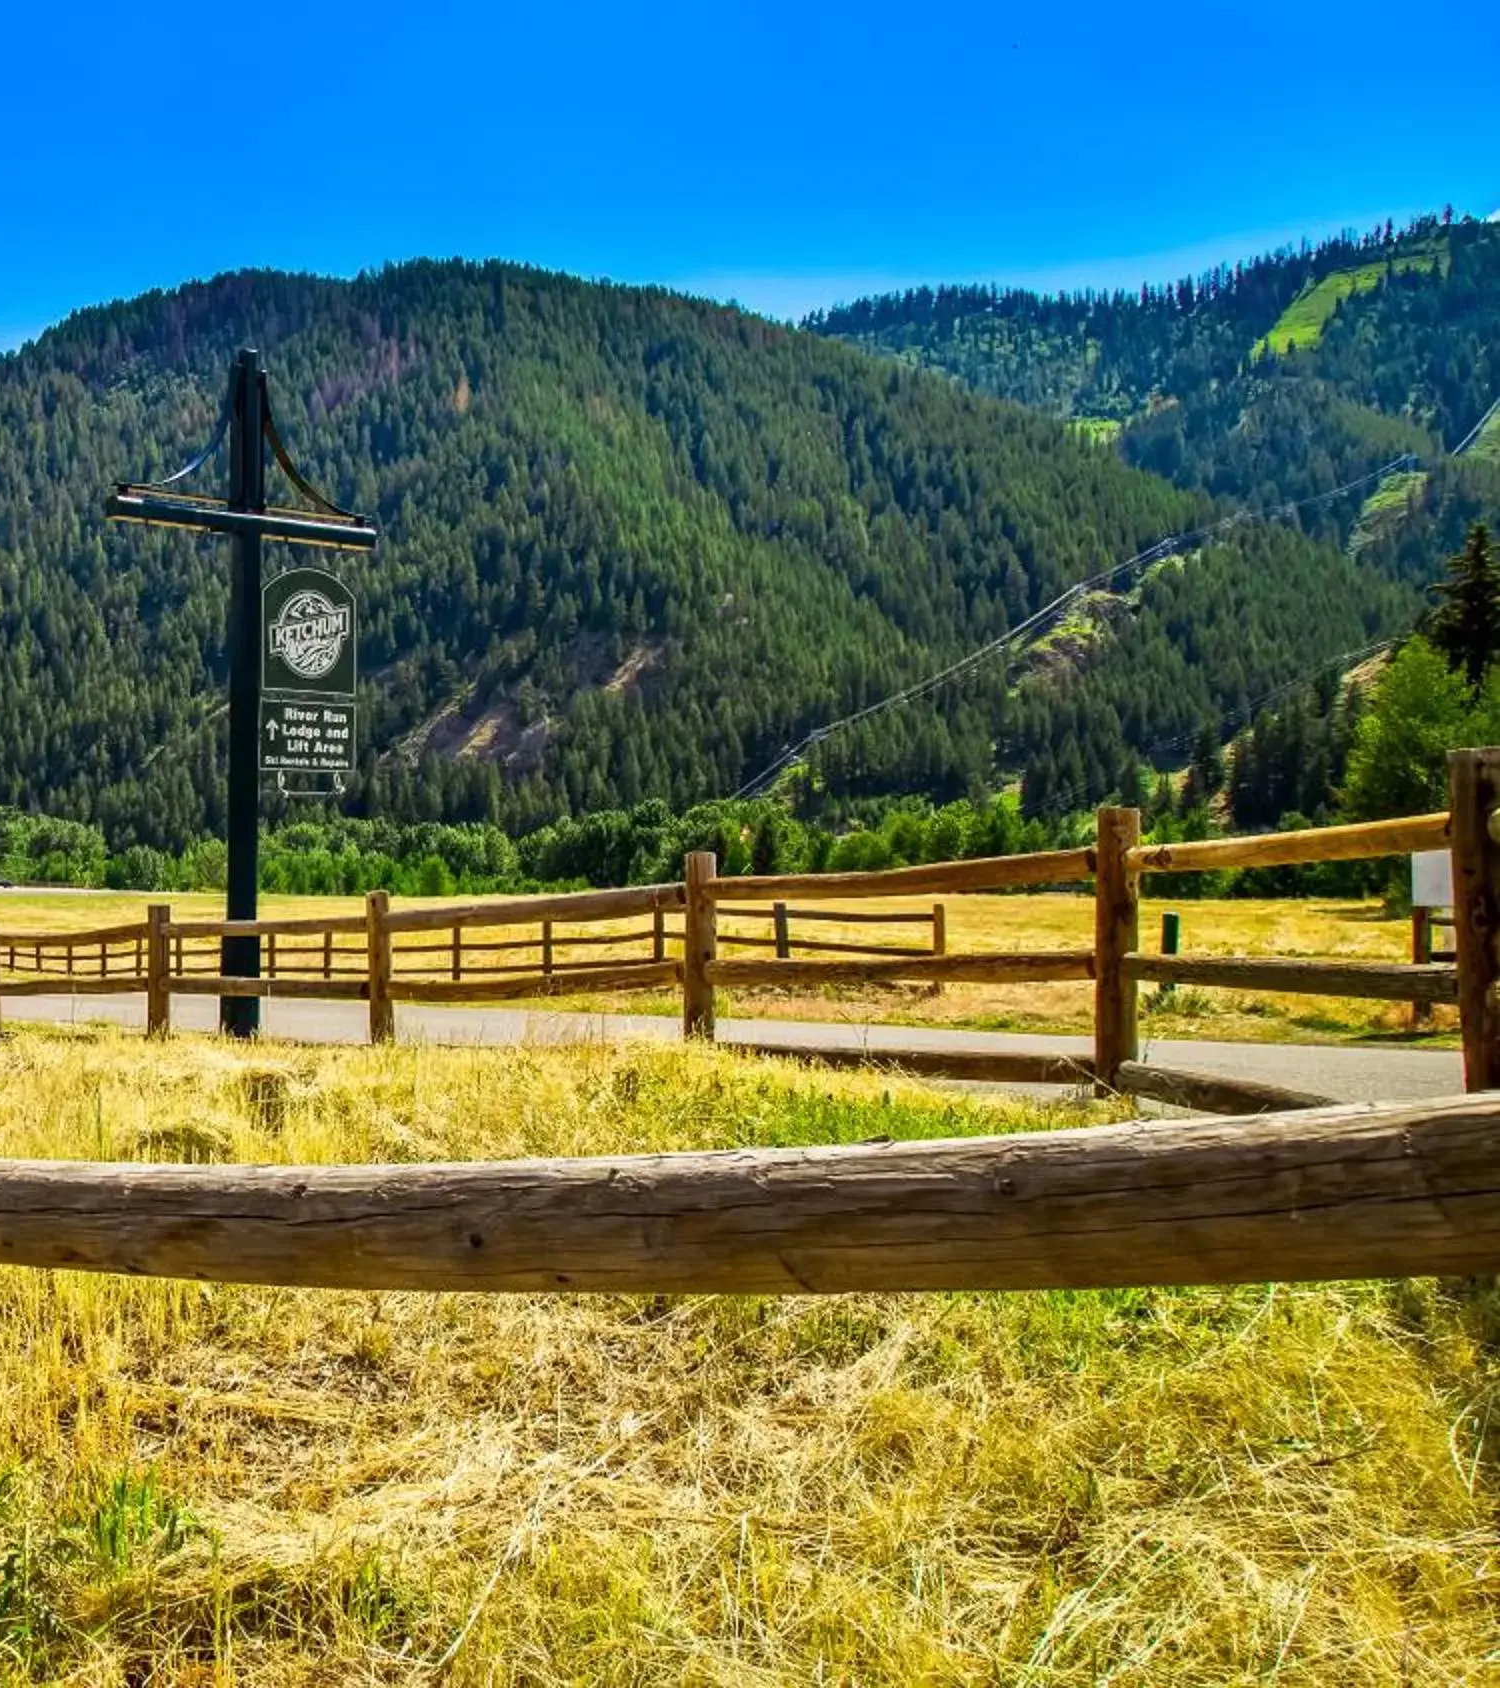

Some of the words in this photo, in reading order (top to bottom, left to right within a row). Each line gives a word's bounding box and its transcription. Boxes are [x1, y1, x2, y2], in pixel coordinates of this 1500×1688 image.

[276, 613, 343, 647] KETCHUM
[284, 707, 319, 721] River
[323, 709, 347, 724] Run
[282, 723, 321, 739] Lodge
[325, 727, 349, 739] and
[287, 739, 309, 753] Lift
[313, 741, 345, 754] Area
